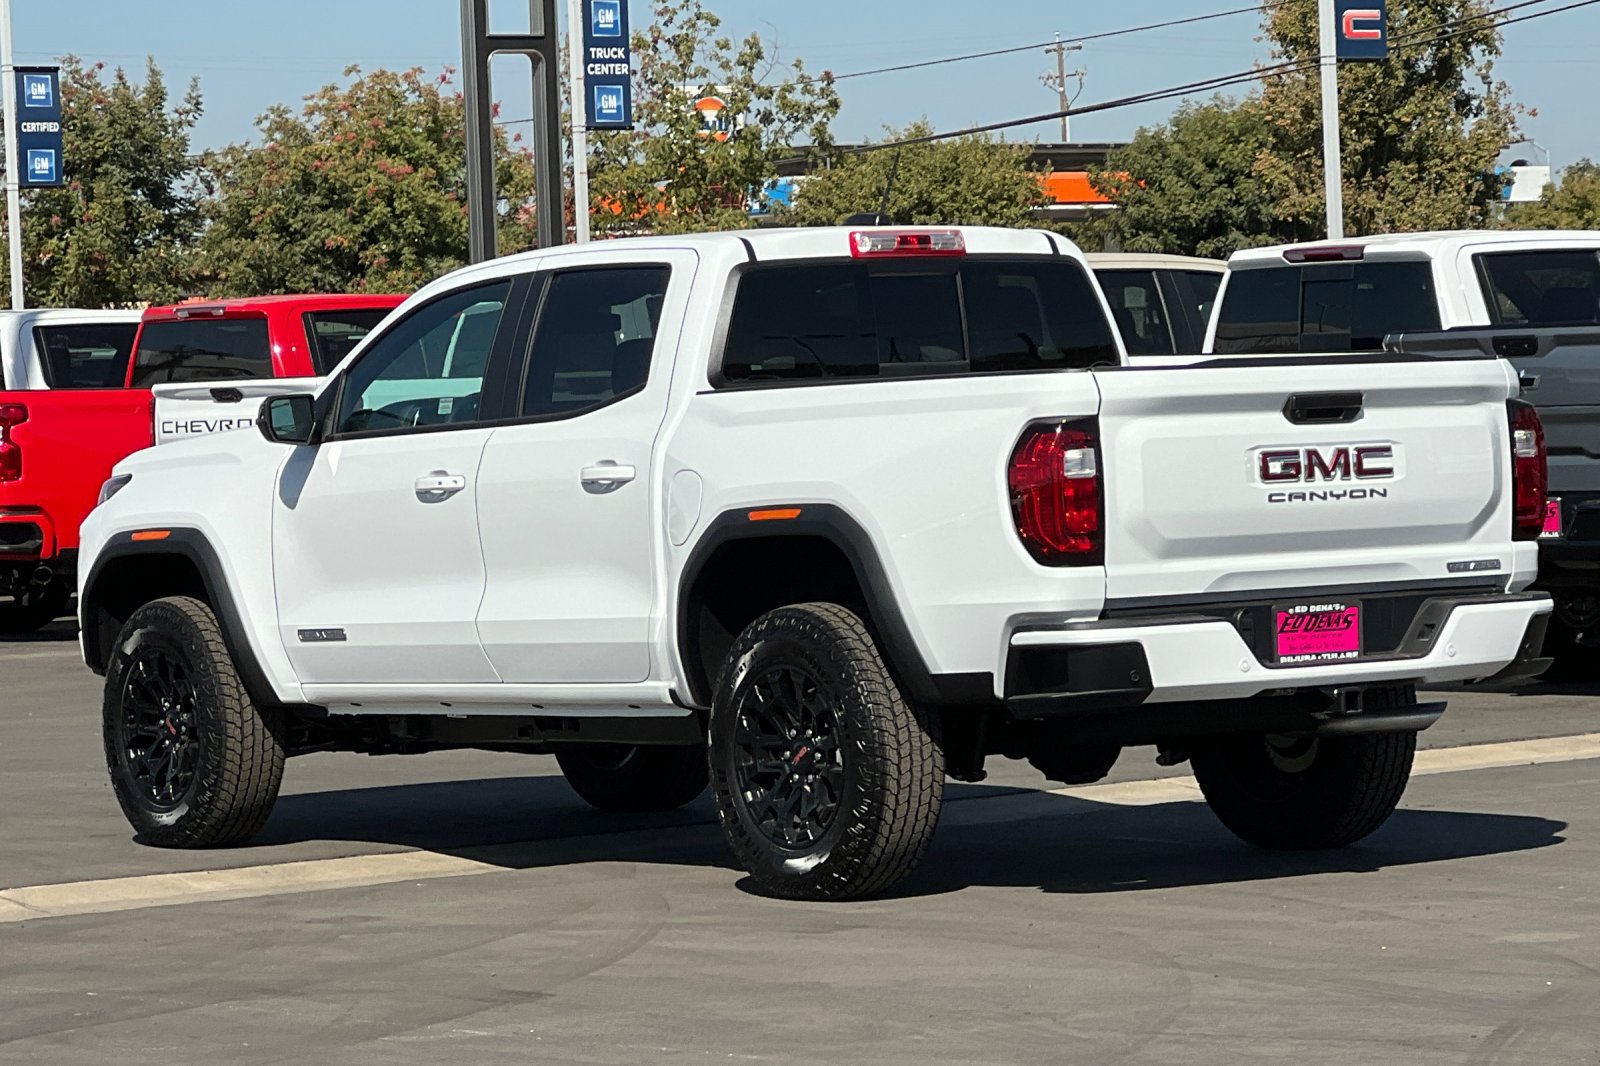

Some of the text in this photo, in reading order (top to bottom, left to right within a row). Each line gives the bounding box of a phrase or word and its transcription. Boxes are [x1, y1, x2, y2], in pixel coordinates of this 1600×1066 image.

[598, 8, 614, 24] GM
[590, 47, 625, 59] TRUCK
[587, 63, 629, 75] CENTER
[31, 82, 46, 96] GM
[601, 94, 617, 109] GM
[21, 122, 60, 133] CERTIFIED
[34, 157, 49, 170] GM
[1259, 444, 1395, 484] GMC
[1267, 488, 1388, 503] CANYON
